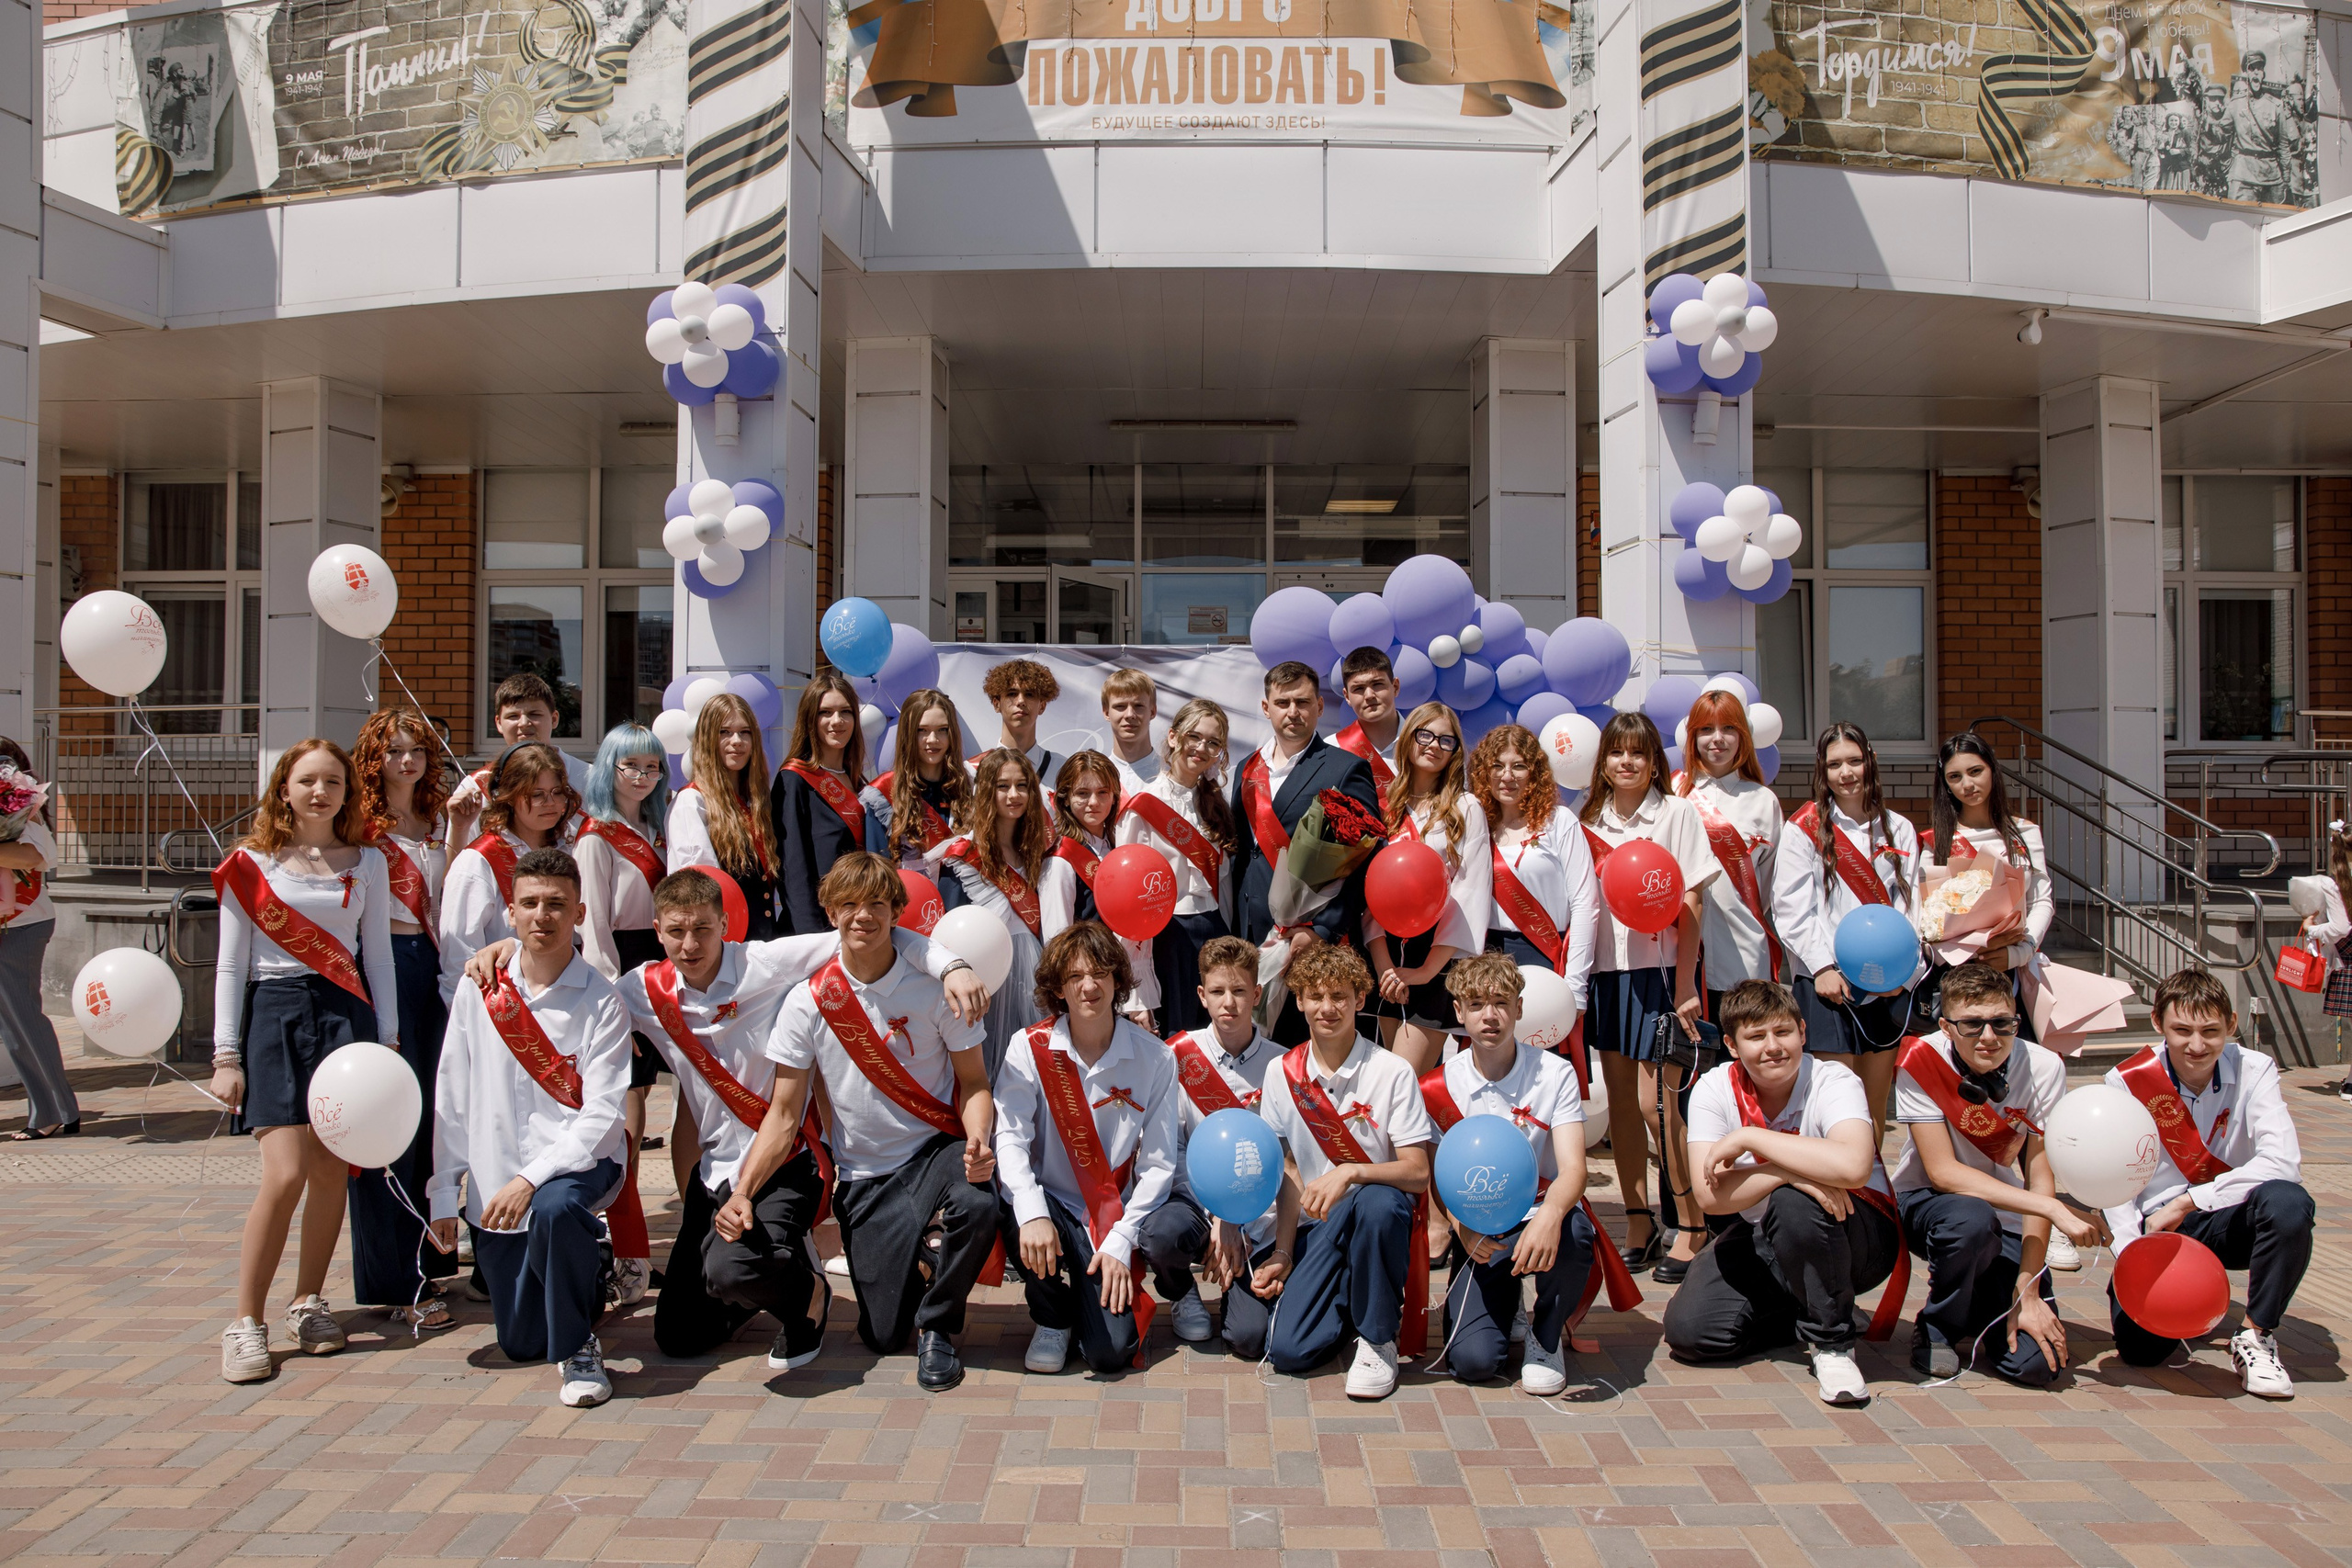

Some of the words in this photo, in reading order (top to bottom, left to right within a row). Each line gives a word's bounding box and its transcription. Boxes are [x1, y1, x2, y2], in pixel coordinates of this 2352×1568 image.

[328, 9, 490, 119] Помним!
[1796, 17, 1977, 118] Гордимся!
[2095, 26, 2127, 82] 9
[286, 73, 294, 84] 9
[297, 70, 323, 83] МАЯ
[1028, 45, 1385, 106] ПОЖАЛОВАТЬ!
[1891, 80, 1949, 96] 1941-1945
[285, 84, 324, 96] 1941-1945
[1091, 116, 1174, 130] БУДУЩЕЕ
[1178, 116, 1261, 130] СОЗДАЮТ
[1265, 116, 1326, 130] ЗДЕСЬ!
[1638, 869, 1671, 897] Всё
[1456, 1166, 1510, 1194] Всё
[1466, 1190, 1504, 1201] только
